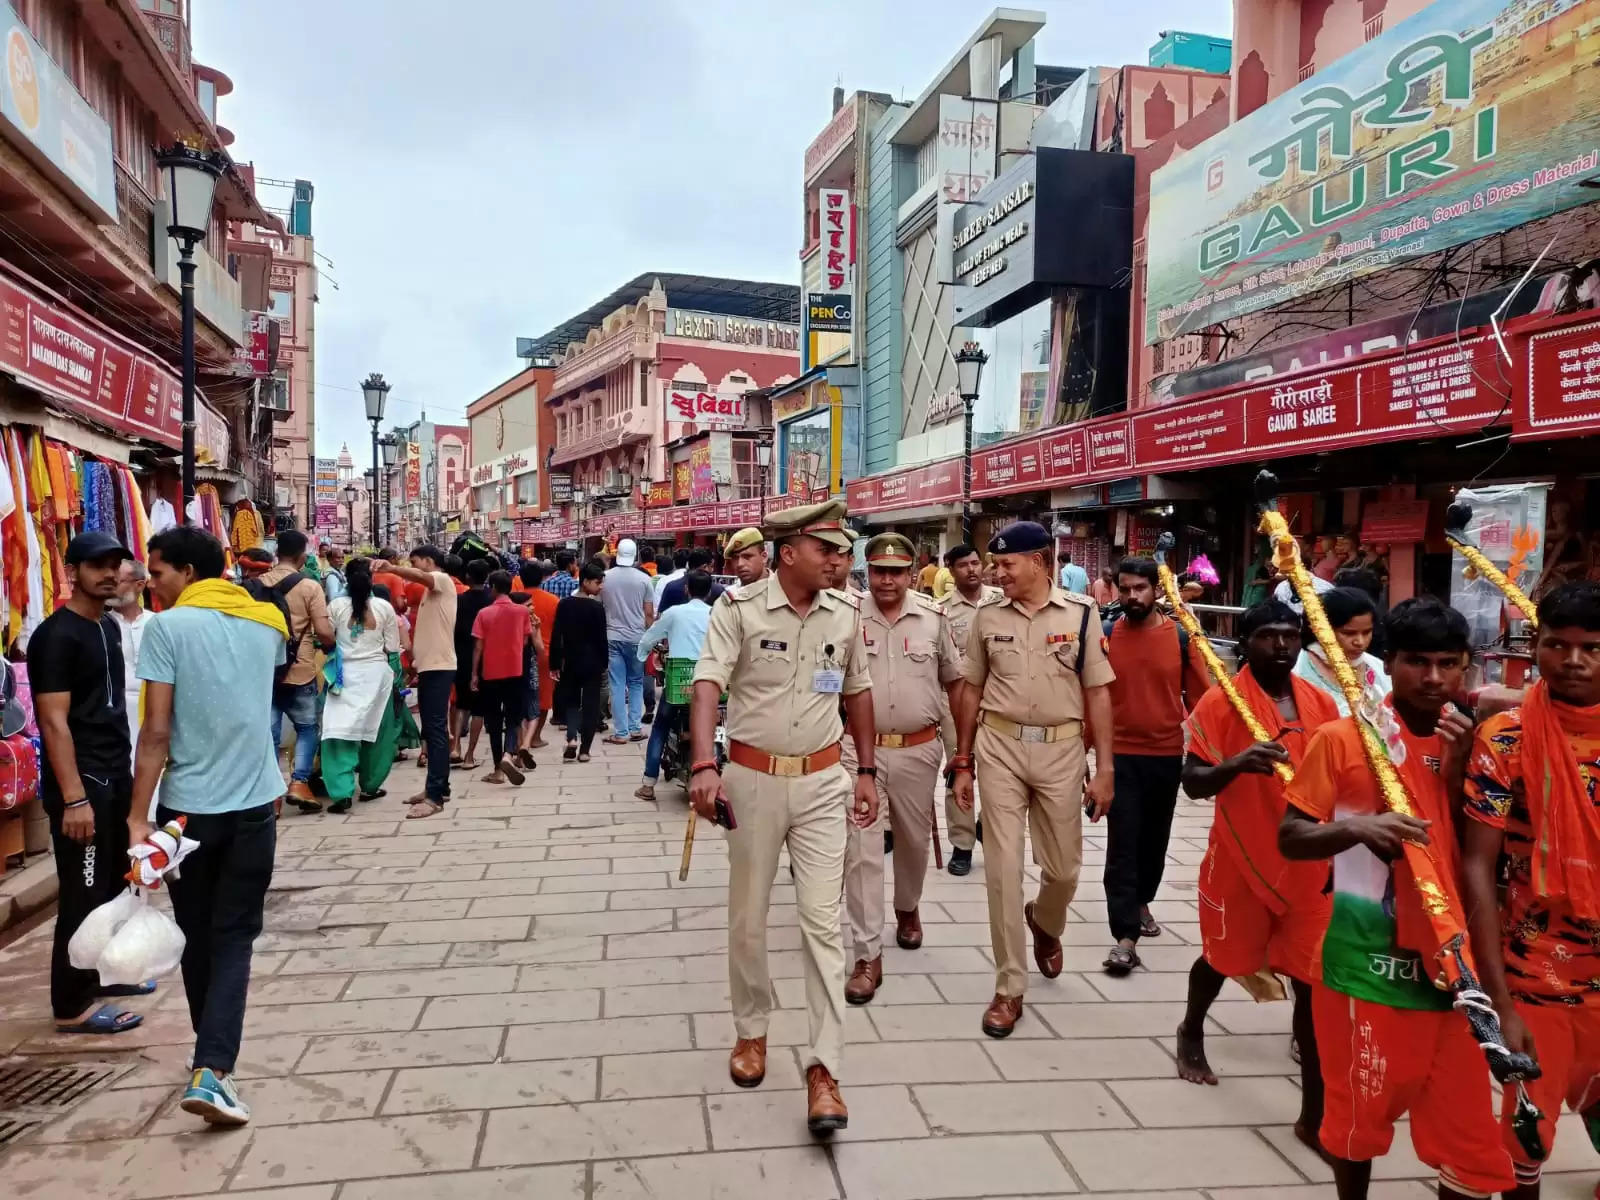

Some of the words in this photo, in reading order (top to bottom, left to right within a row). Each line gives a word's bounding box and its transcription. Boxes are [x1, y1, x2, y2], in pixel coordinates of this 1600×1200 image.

[1199, 104, 1498, 274] GAURI
[1207, 160, 1224, 193] G
[987, 180, 1030, 226] SANSAR
[1380, 215, 1430, 243] Dupatta,
[1432, 198, 1470, 224] Gown
[1472, 193, 1484, 209] &
[1486, 179, 1529, 205] Dress
[1531, 148, 1599, 190] Material
[810, 295, 823, 303] THE
[674, 310, 721, 341] Laxmi
[1428, 358, 1437, 368] OF
[1438, 348, 1475, 366] EXCLUSVE
[1449, 373, 1472, 387] DRESS
[1450, 386, 1477, 401] CHUNNI
[671, 391, 742, 420] सुविधा
[1267, 411, 1298, 434] GAURI
[1302, 404, 1337, 427] SAREE
[82, 845, 97, 887] adidas
